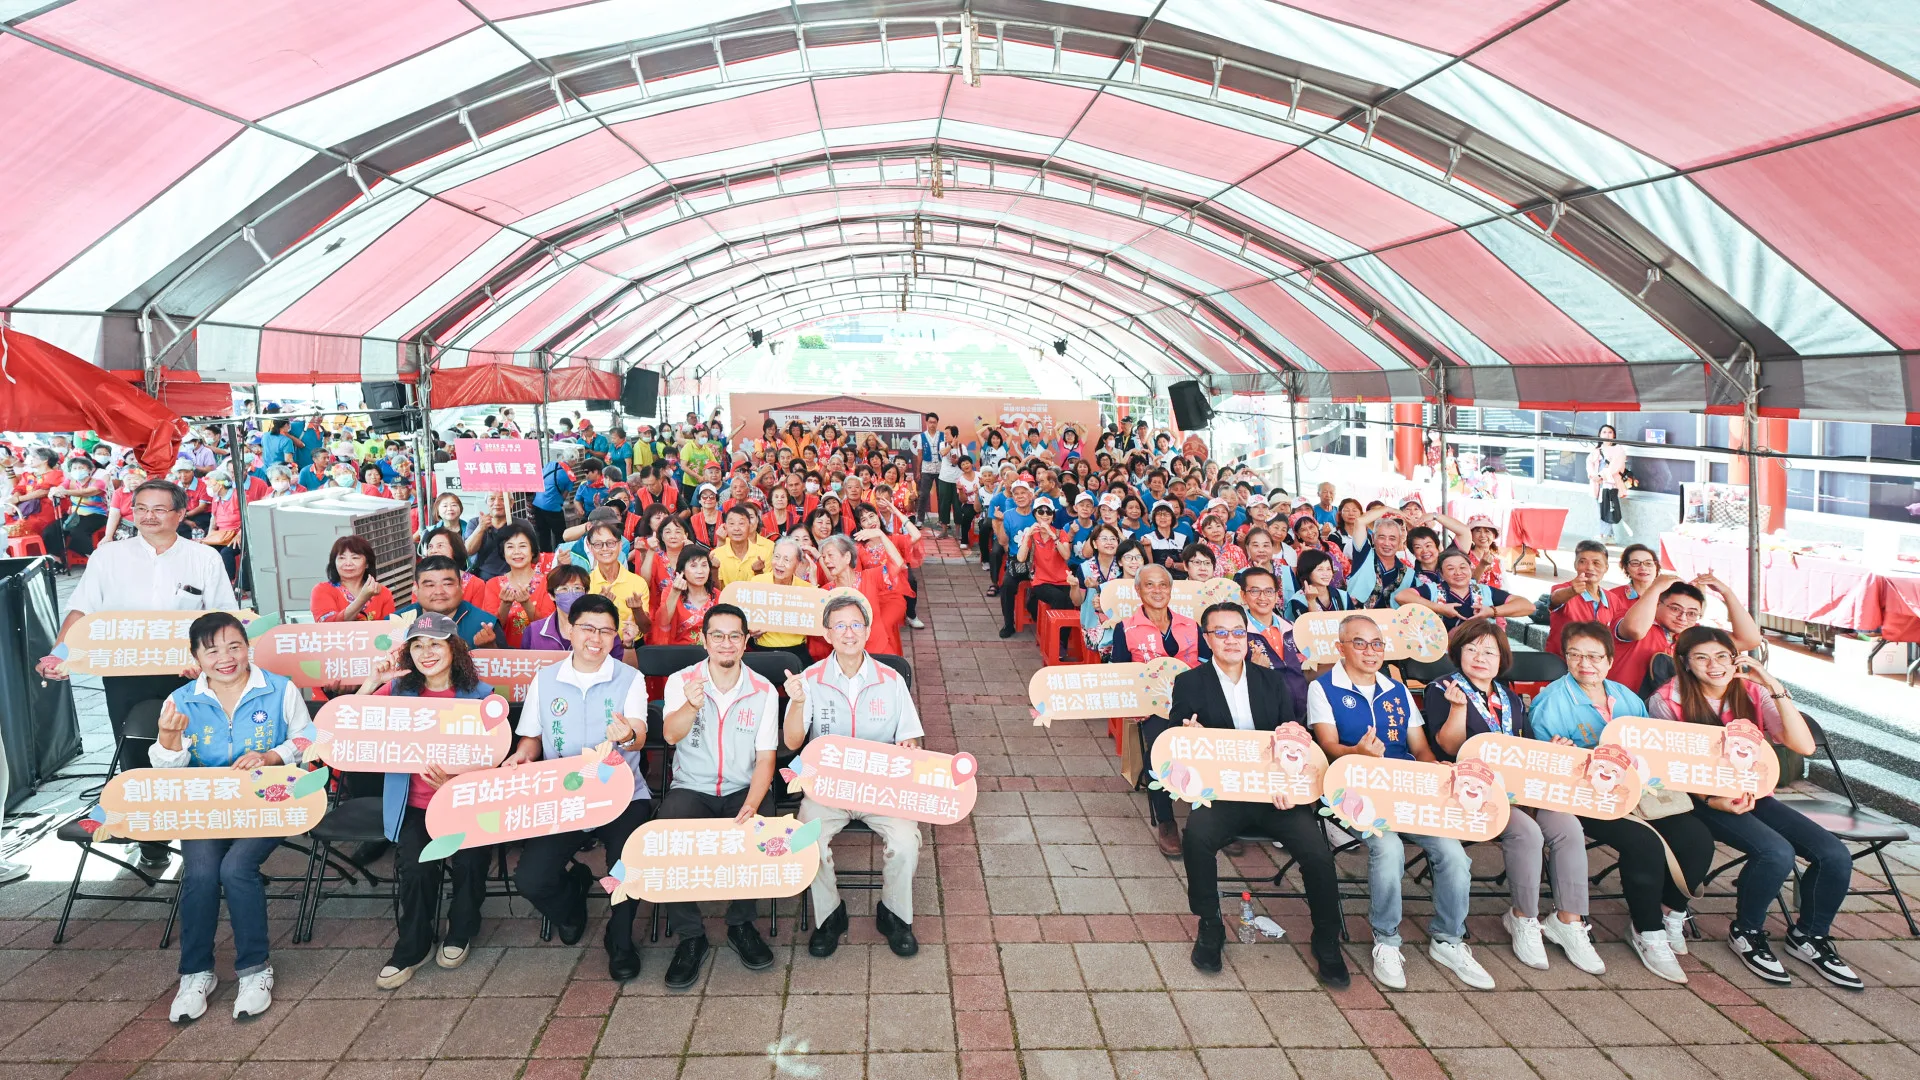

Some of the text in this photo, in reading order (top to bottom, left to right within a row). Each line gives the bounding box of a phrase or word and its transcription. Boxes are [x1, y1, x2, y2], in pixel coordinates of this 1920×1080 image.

[736, 588, 783, 606] 桃園市
[274, 630, 370, 654] 百站共行
[1046, 672, 1098, 690] 桃園市
[1050, 691, 1138, 712] 伯公照護站
[335, 704, 437, 732] 全國最多
[332, 740, 495, 766] 桃園伯公照護站
[1169, 736, 1262, 763] 伯公照護
[1619, 725, 1711, 757] 伯公照護
[819, 743, 912, 778] 全國最多
[1478, 741, 1576, 777] 伯公照護
[122, 777, 242, 802] 創新客家
[451, 769, 559, 808] 百站共行
[1219, 769, 1312, 797] 客庄長者
[1344, 763, 1440, 798] 伯公照護
[1667, 760, 1761, 793] 客庄長者
[814, 775, 961, 819] 桃園伯公照護站
[1523, 777, 1621, 814] 客庄長者
[126, 807, 309, 833] 青銀共創新風華
[504, 796, 613, 832] 桃園第一
[1393, 801, 1490, 834] 客庄長者
[642, 829, 747, 857] 創新客家
[642, 863, 804, 892] 青銀共創新風華
